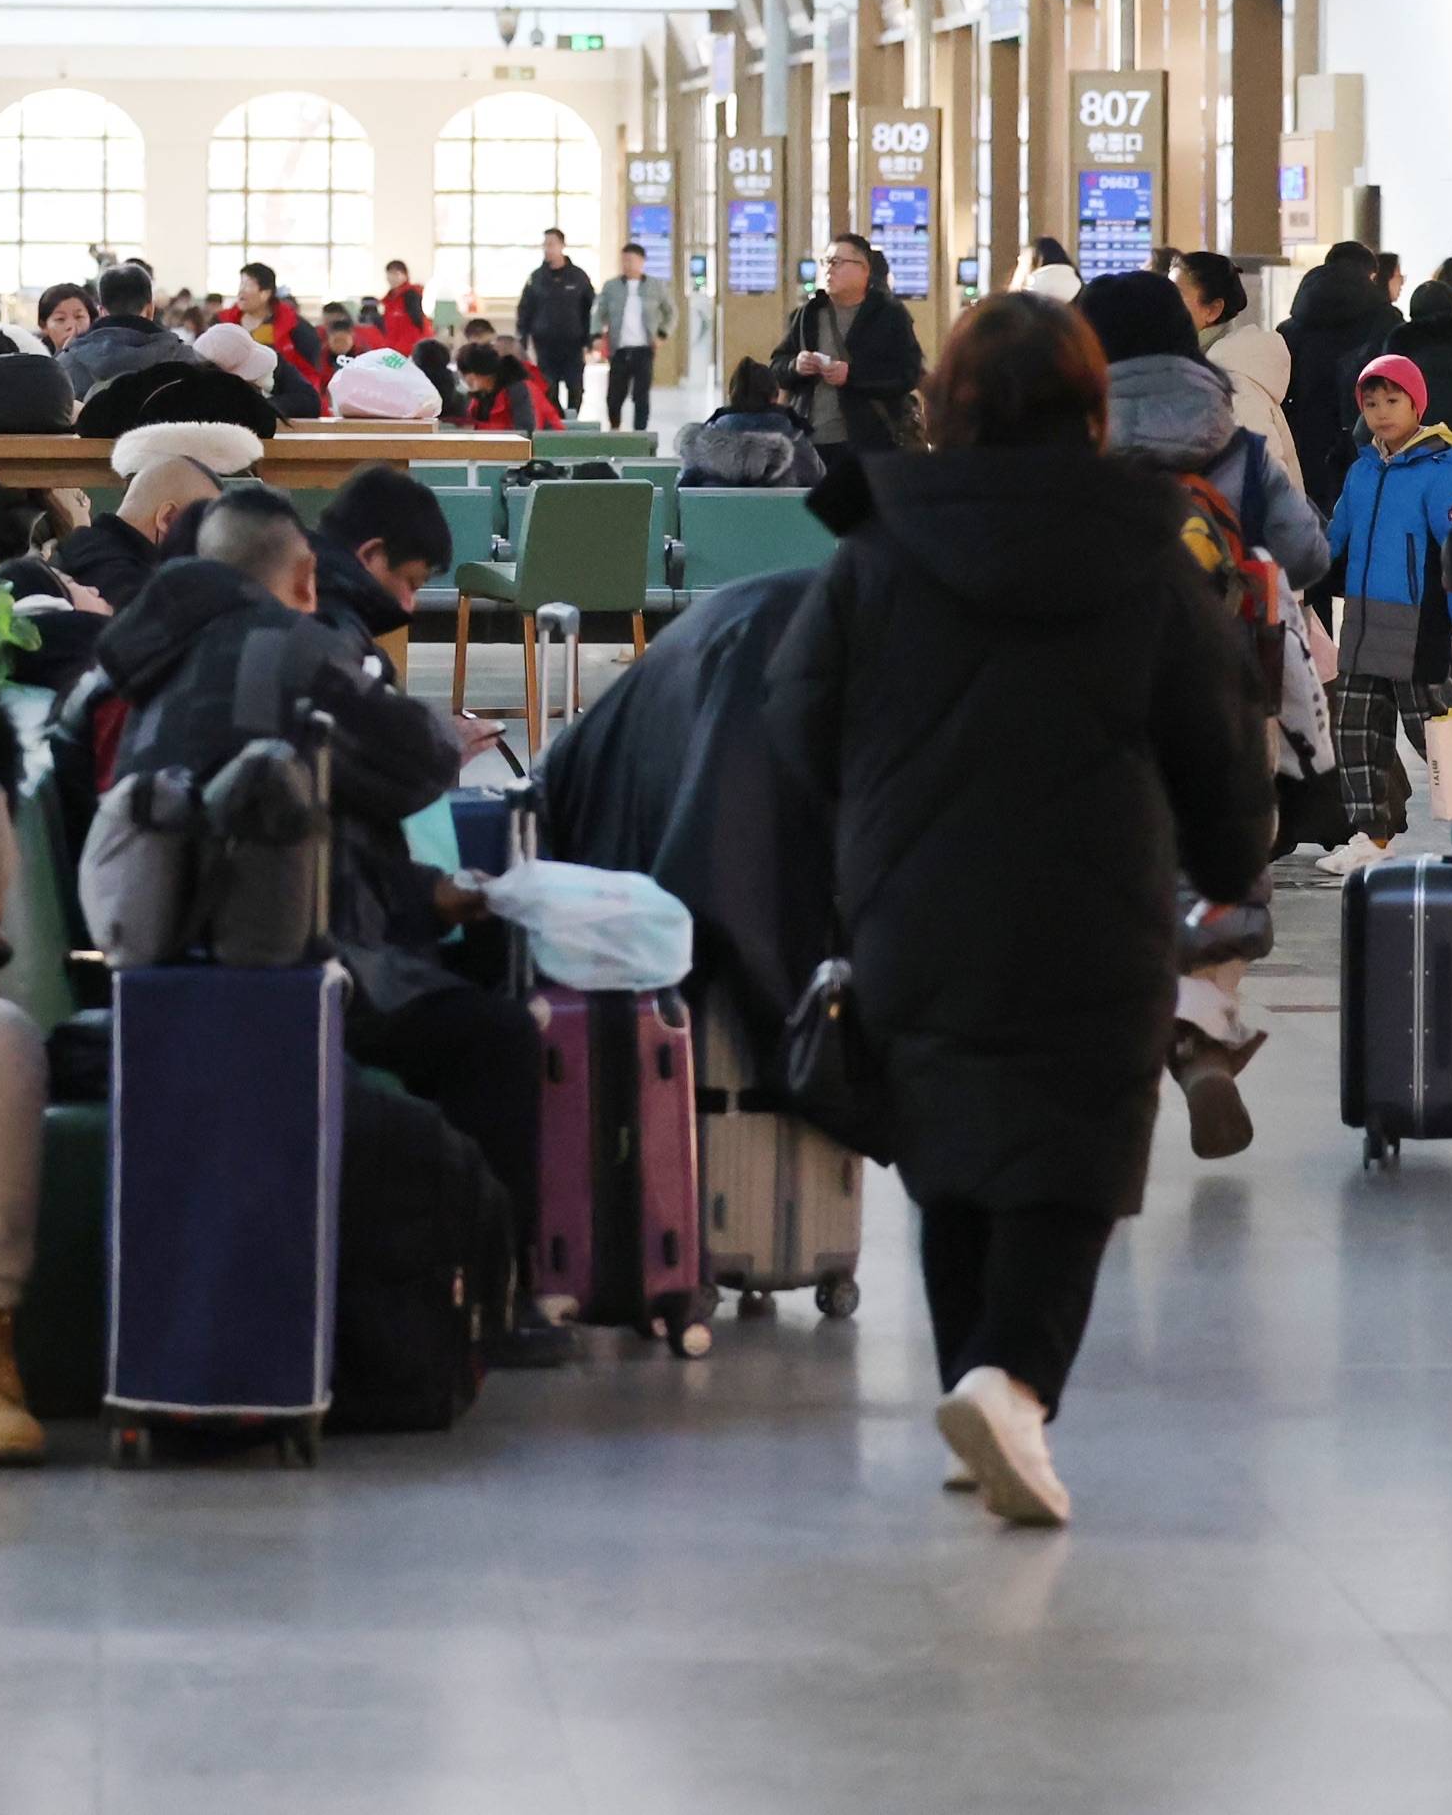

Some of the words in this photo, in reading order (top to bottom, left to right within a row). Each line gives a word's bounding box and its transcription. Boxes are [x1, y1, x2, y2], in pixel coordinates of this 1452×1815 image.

[1080, 89, 1151, 127] 807
[872, 122, 929, 153] 809
[629, 159, 672, 184] 813
[728, 147, 772, 173] 811
